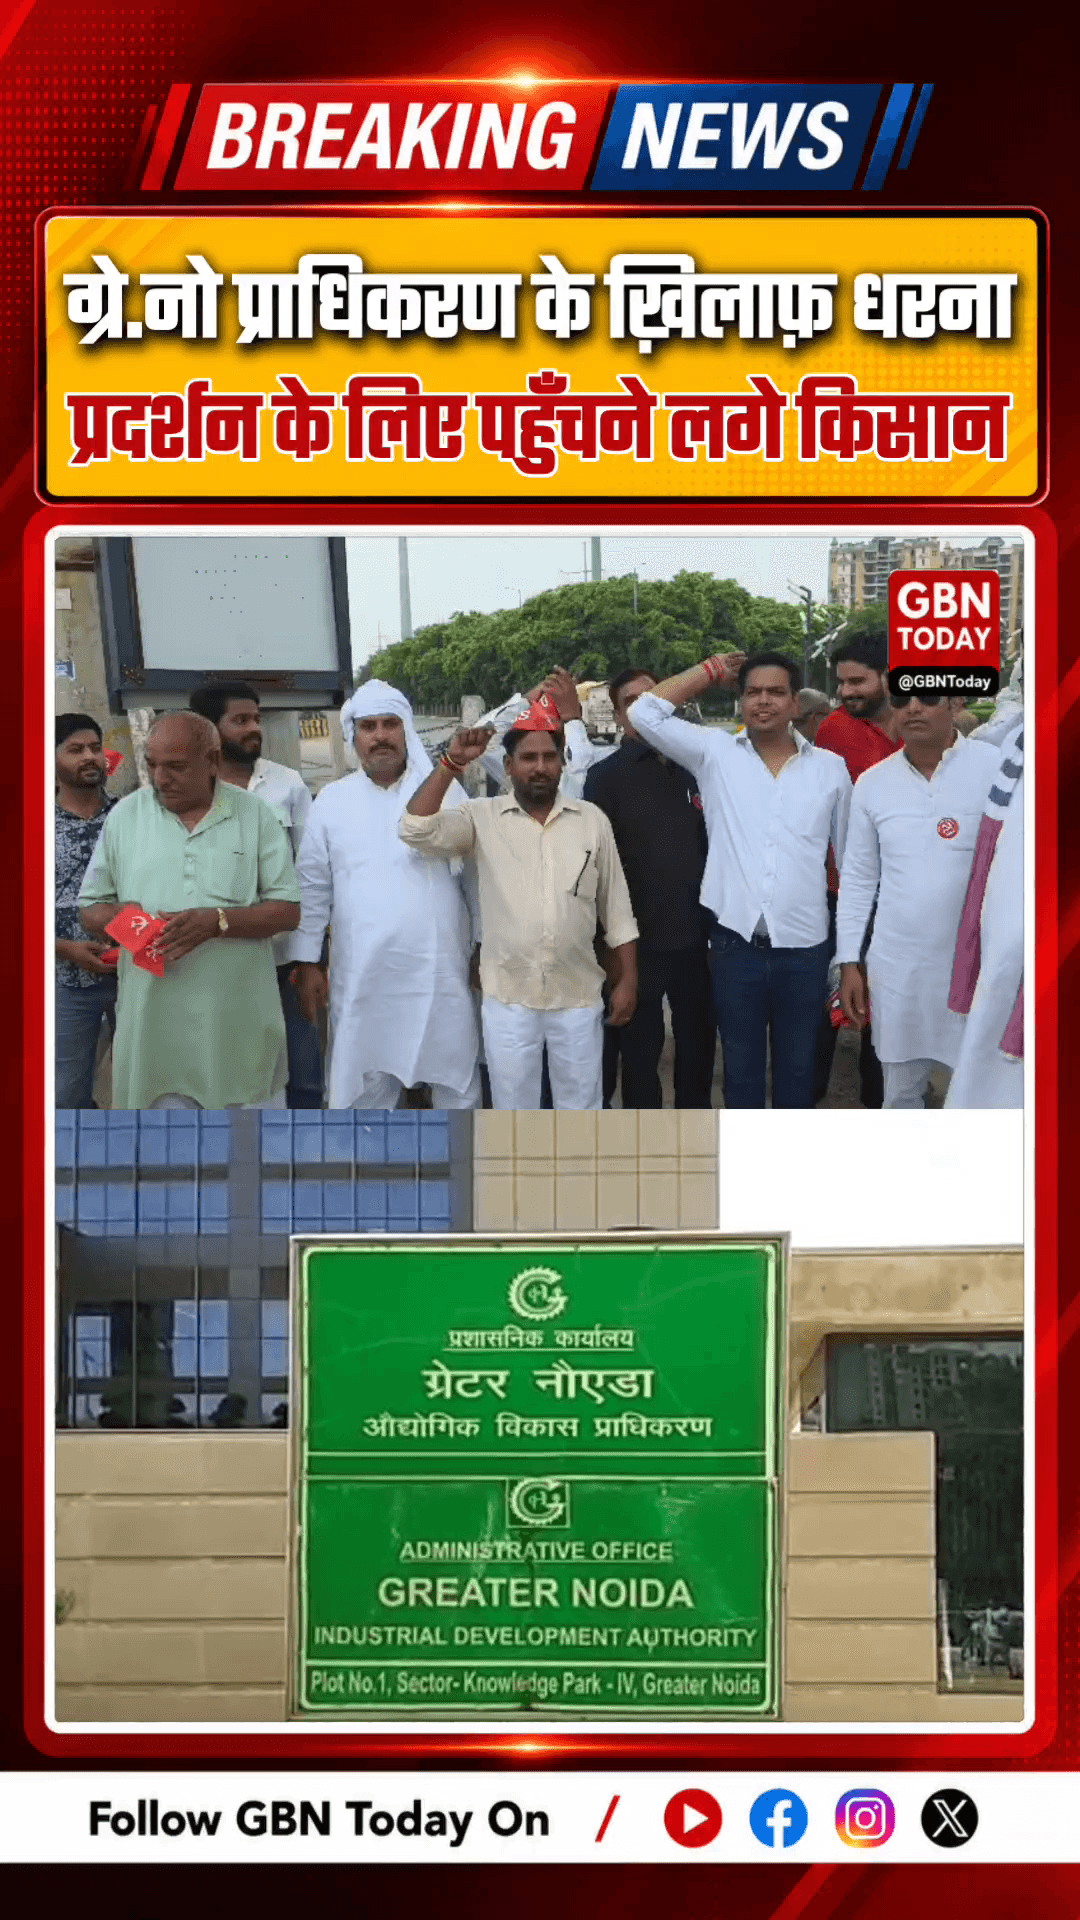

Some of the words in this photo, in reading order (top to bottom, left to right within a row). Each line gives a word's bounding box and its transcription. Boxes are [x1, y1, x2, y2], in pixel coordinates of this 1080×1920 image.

[447, 1324, 545, 1348] प्रशासनिक
[554, 1323, 635, 1348] कार्यालय
[421, 1359, 510, 1399] ग्रेटर
[533, 1359, 656, 1405] नौएडा
[363, 1412, 480, 1438] औद्योगिक
[495, 1412, 580, 1437] विकास
[593, 1412, 714, 1438] प्राधिकरण
[400, 1540, 585, 1561] ADMINISTRATIVE
[592, 1541, 673, 1561] OFFICE
[378, 1577, 560, 1608] GREATER
[572, 1578, 695, 1608] NOIDA
[314, 1626, 447, 1645] INDUSTRIAL
[454, 1626, 621, 1646] DEVELOPMENT
[626, 1627, 757, 1648] AUTHORITY
[311, 1670, 345, 1693] Plot
[464, 1671, 558, 1699] Knowledge
[563, 1672, 601, 1694] Park
[643, 1672, 708, 1695] Greater
[712, 1673, 760, 1695] Noida
